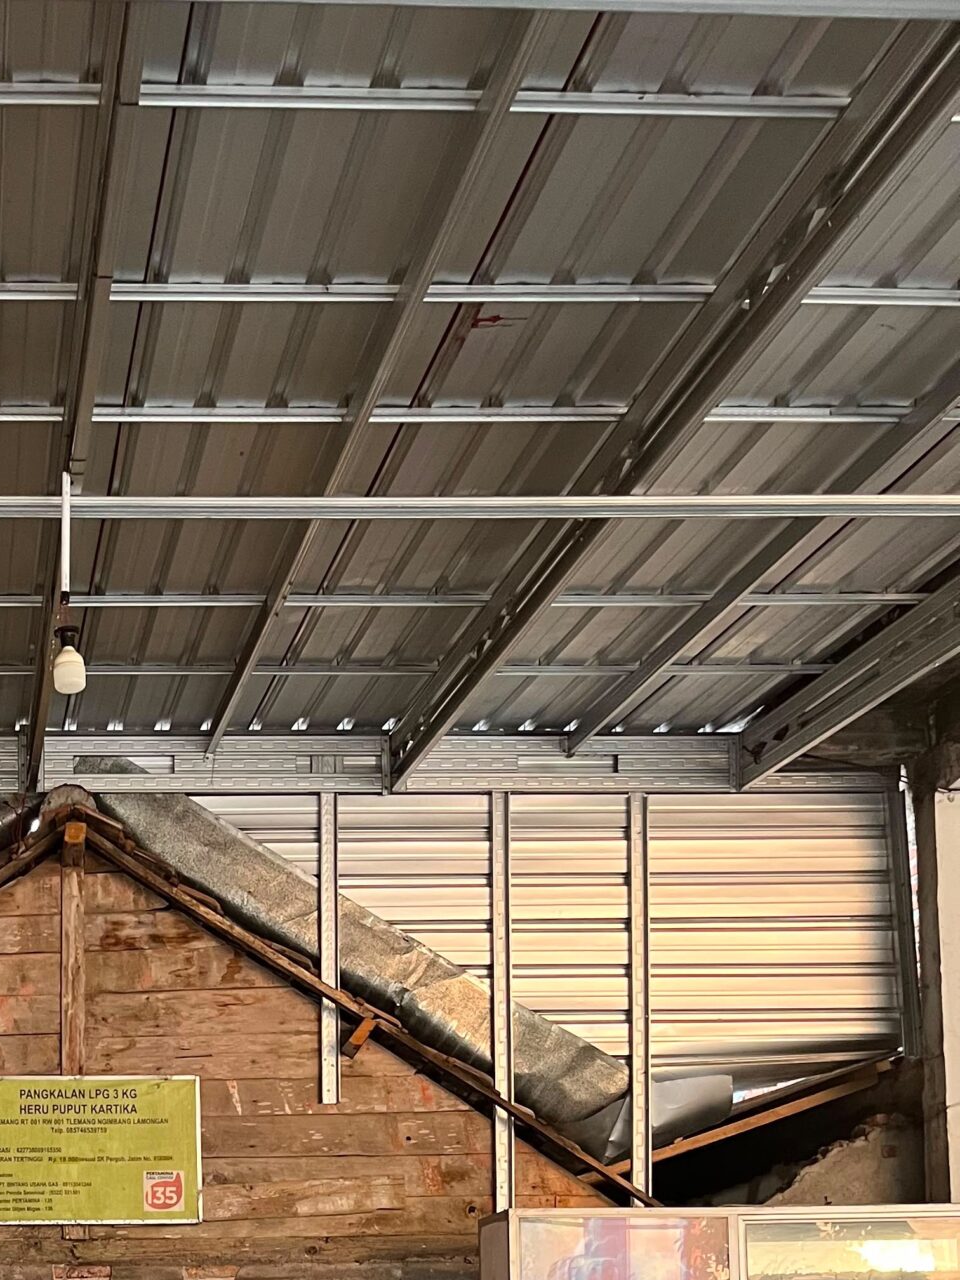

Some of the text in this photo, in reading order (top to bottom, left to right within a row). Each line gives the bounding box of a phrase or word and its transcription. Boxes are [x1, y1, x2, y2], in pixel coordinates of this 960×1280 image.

[19, 1089, 137, 1099] PANGKALAN LPG 3 KG
[19, 1104, 137, 1114] HERU PUPUT KARTIKA
[147, 1186, 178, 1204] 135
